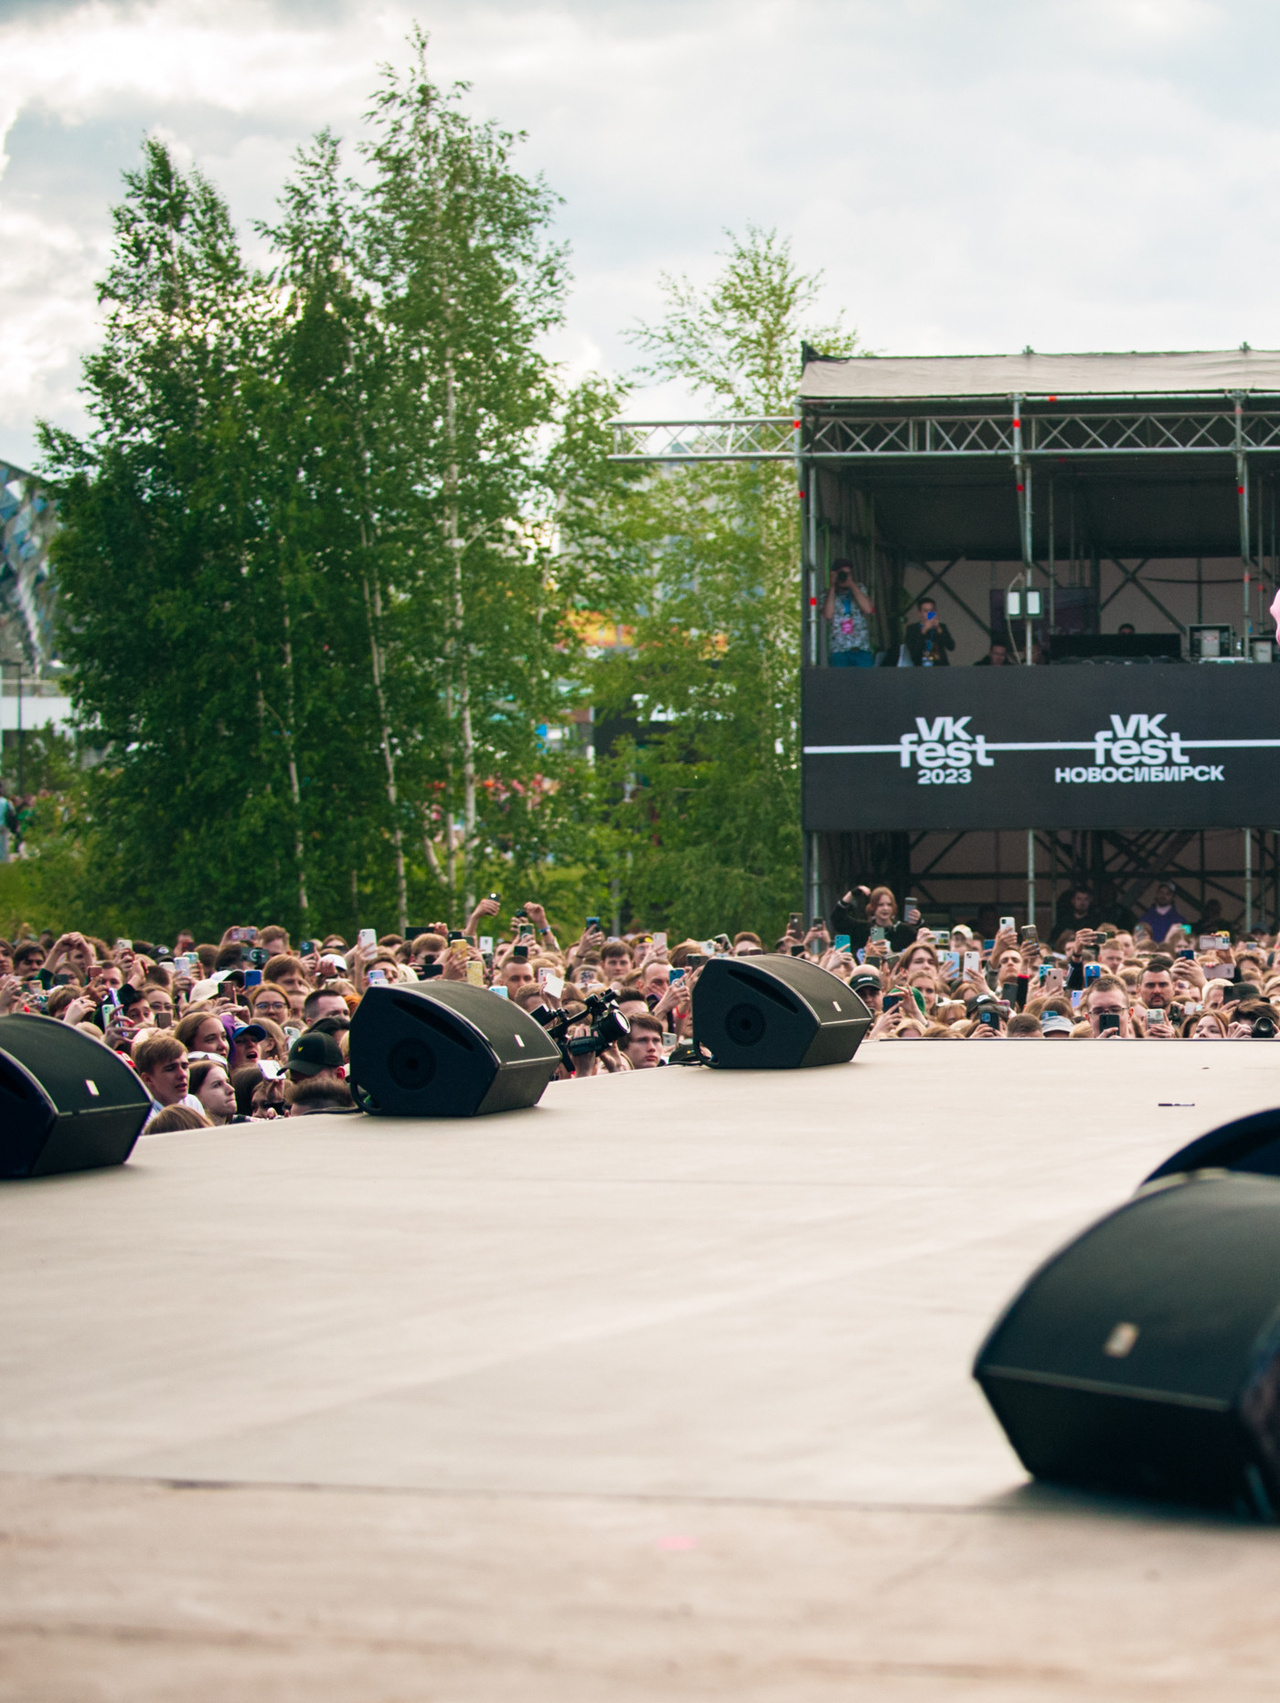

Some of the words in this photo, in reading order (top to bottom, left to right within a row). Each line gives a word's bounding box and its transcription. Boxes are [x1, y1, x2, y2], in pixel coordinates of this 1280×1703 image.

[915, 715, 973, 741] VK
[1110, 713, 1168, 738] VK
[900, 733, 994, 768] fest
[1094, 730, 1190, 765] fest
[917, 768, 972, 785] 2023
[1055, 765, 1225, 783] НОВОСИБИРСК
